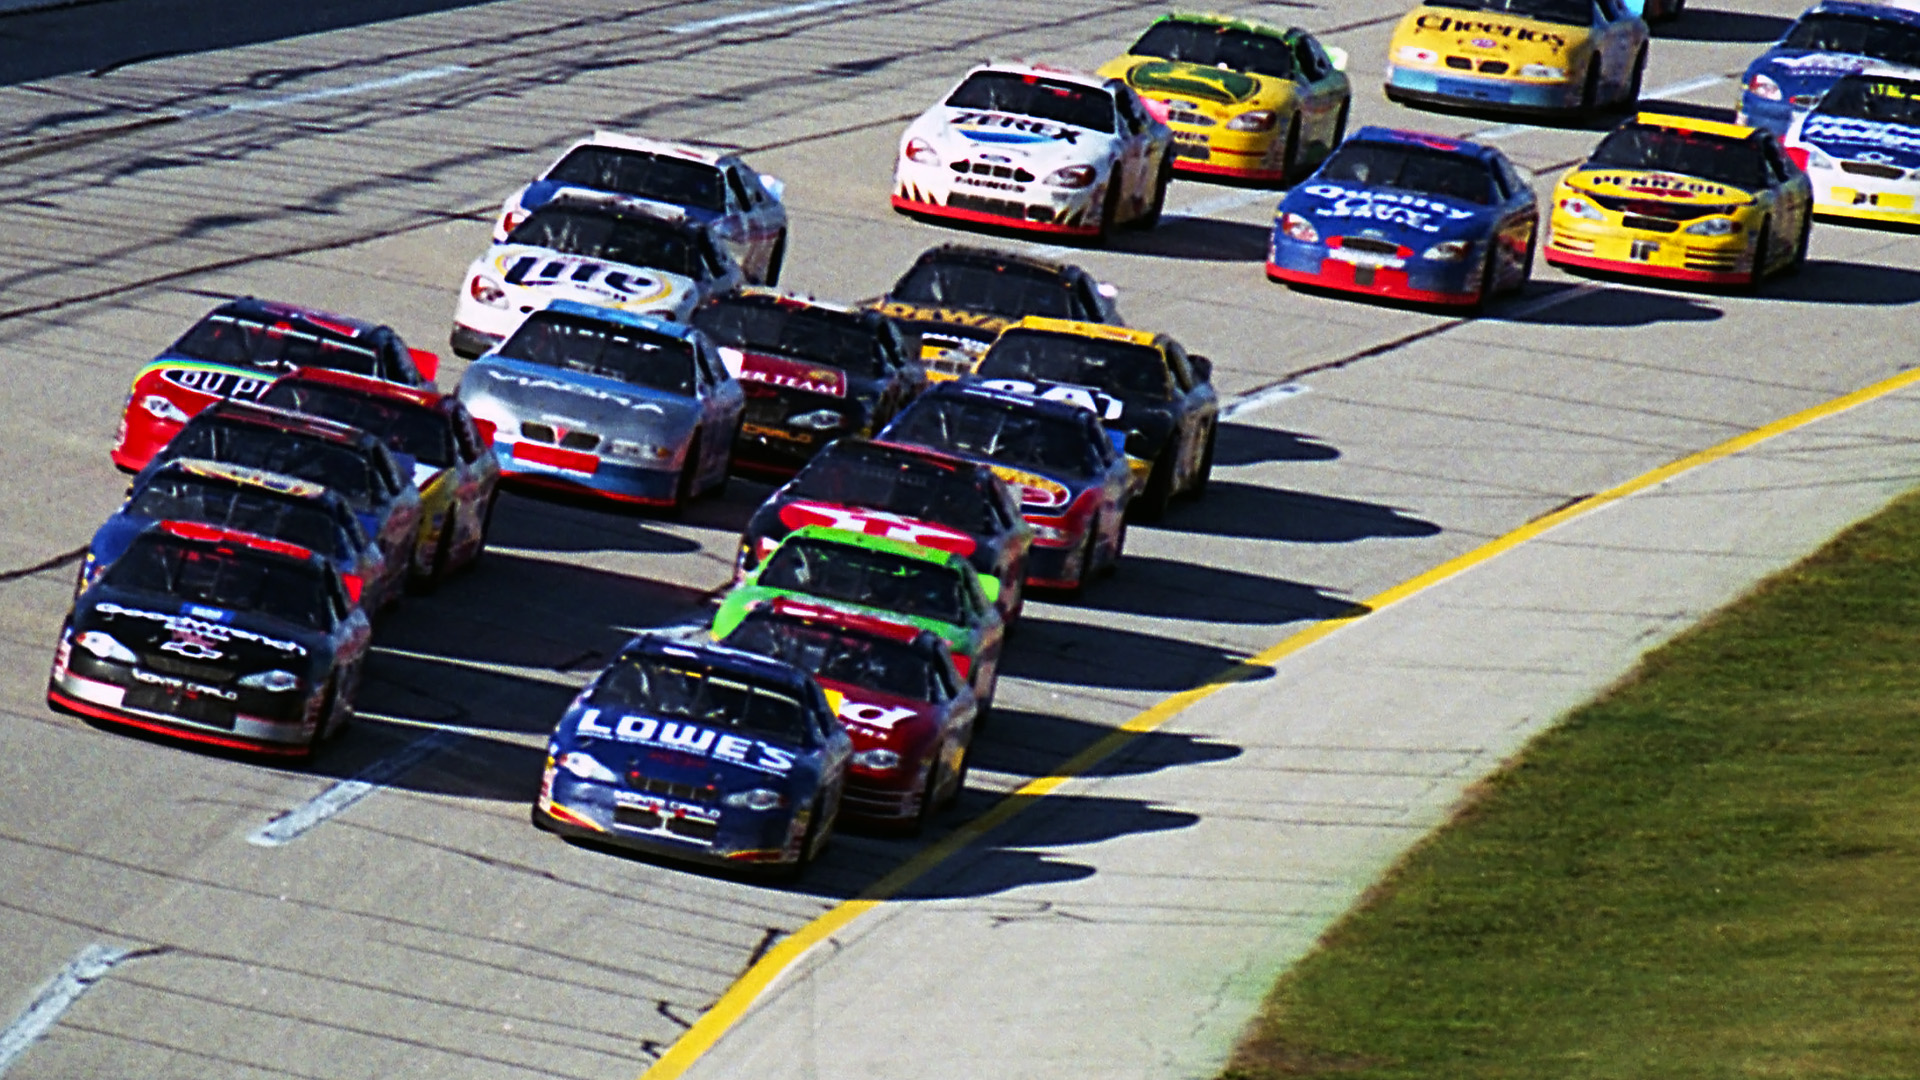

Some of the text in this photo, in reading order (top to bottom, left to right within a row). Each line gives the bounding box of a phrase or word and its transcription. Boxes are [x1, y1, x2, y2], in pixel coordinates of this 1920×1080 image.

[1416, 15, 1565, 47] Cheerios
[949, 110, 1082, 145] ZEREX
[576, 708, 797, 771] LOWE'S
